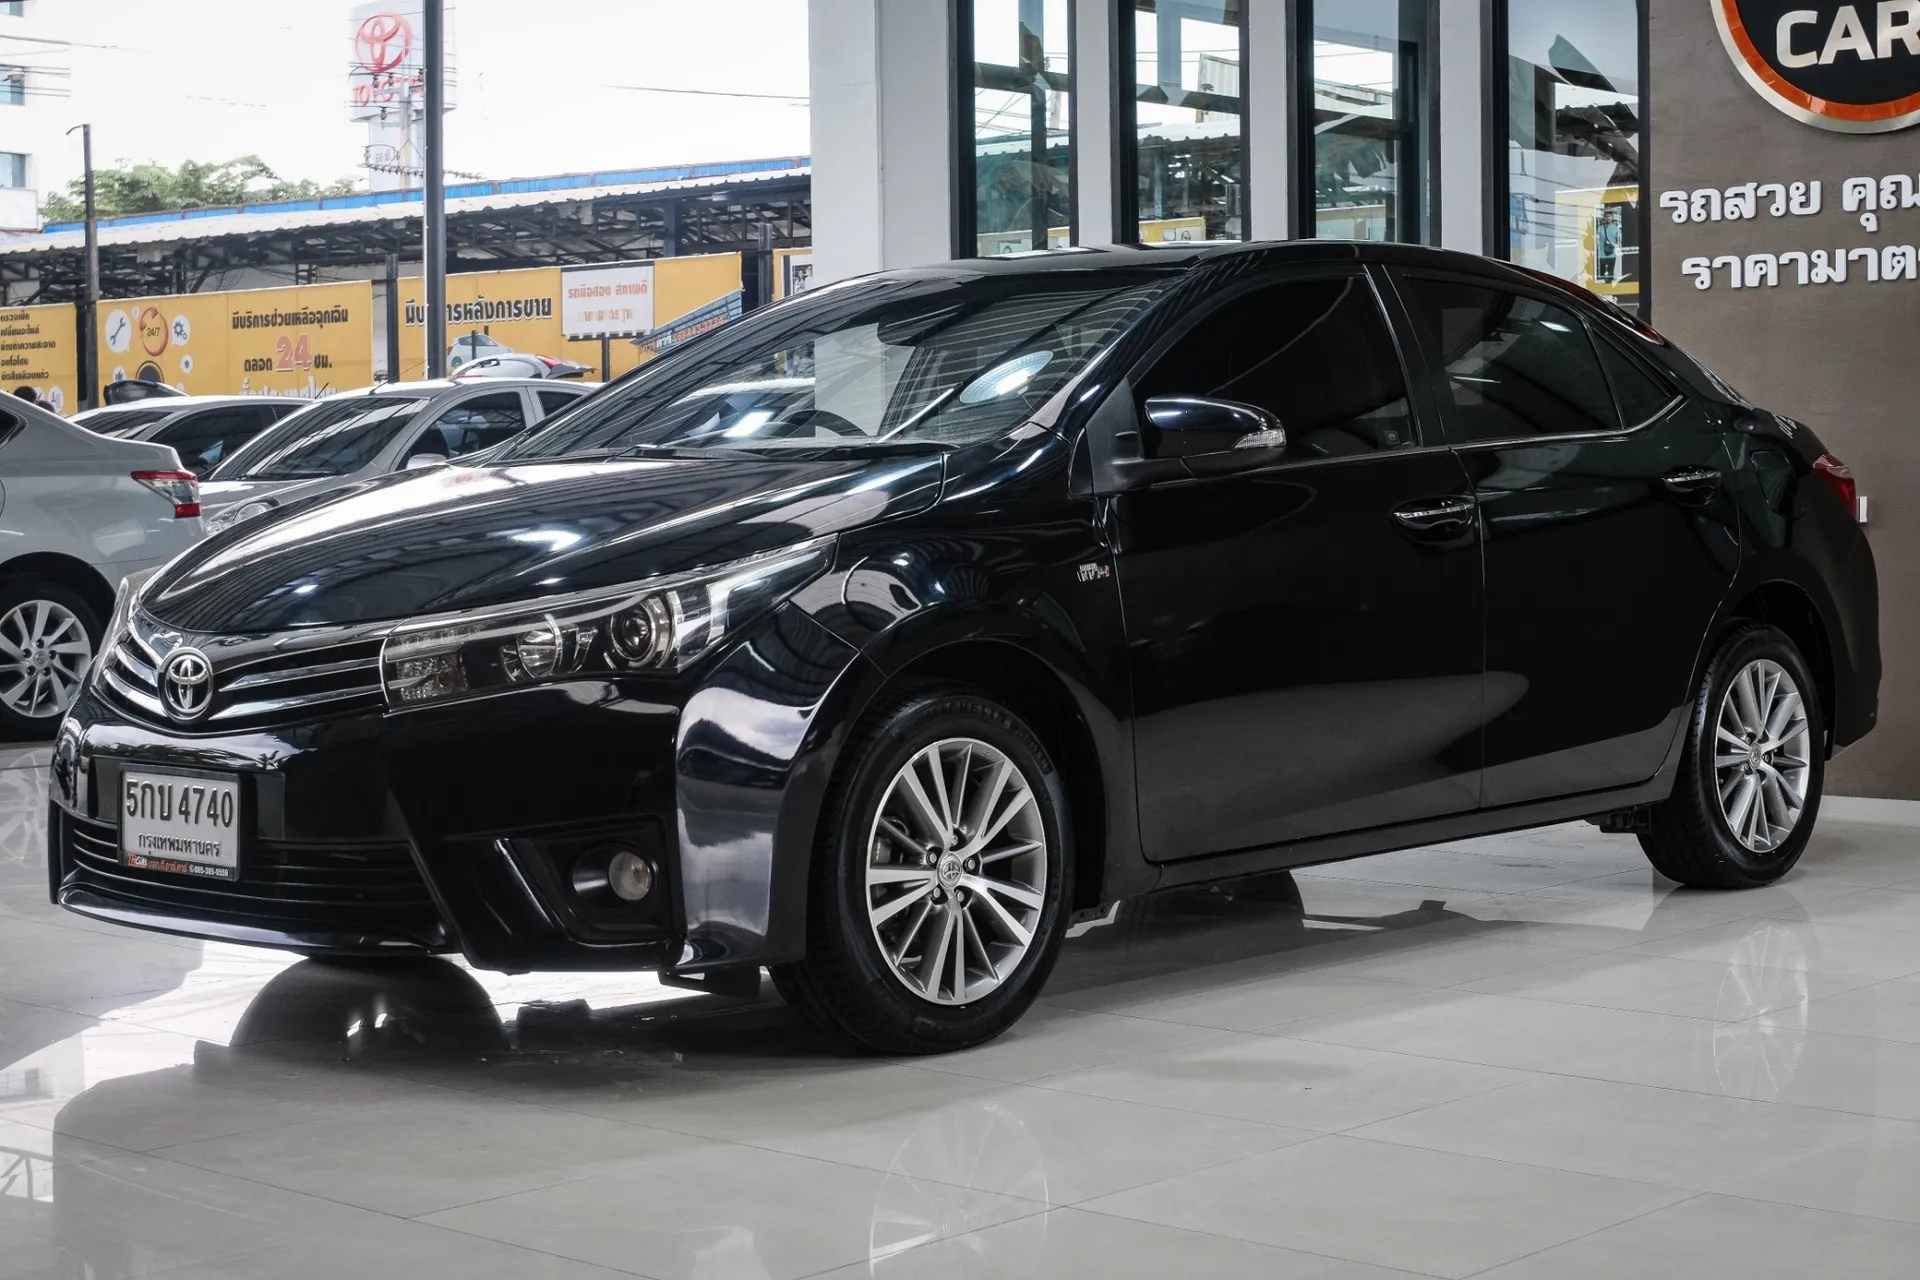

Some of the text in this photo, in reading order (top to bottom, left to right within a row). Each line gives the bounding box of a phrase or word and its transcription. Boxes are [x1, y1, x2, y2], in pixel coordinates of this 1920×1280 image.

[1659, 181, 1822, 224] รถสวย
[1682, 245, 1920, 290] ราคามาต
[232, 304, 348, 329] มีบริการช่วยเหลือฉุกเฉิน
[405, 294, 553, 327] มีบารหลังการขาย
[147, 327, 161, 337] 24/7
[244, 334, 332, 372] ตลอด 24 ชม.
[126, 779, 234, 828] 5กบ 4740
[138, 832, 221, 857] กรุงเทพมหานคร
